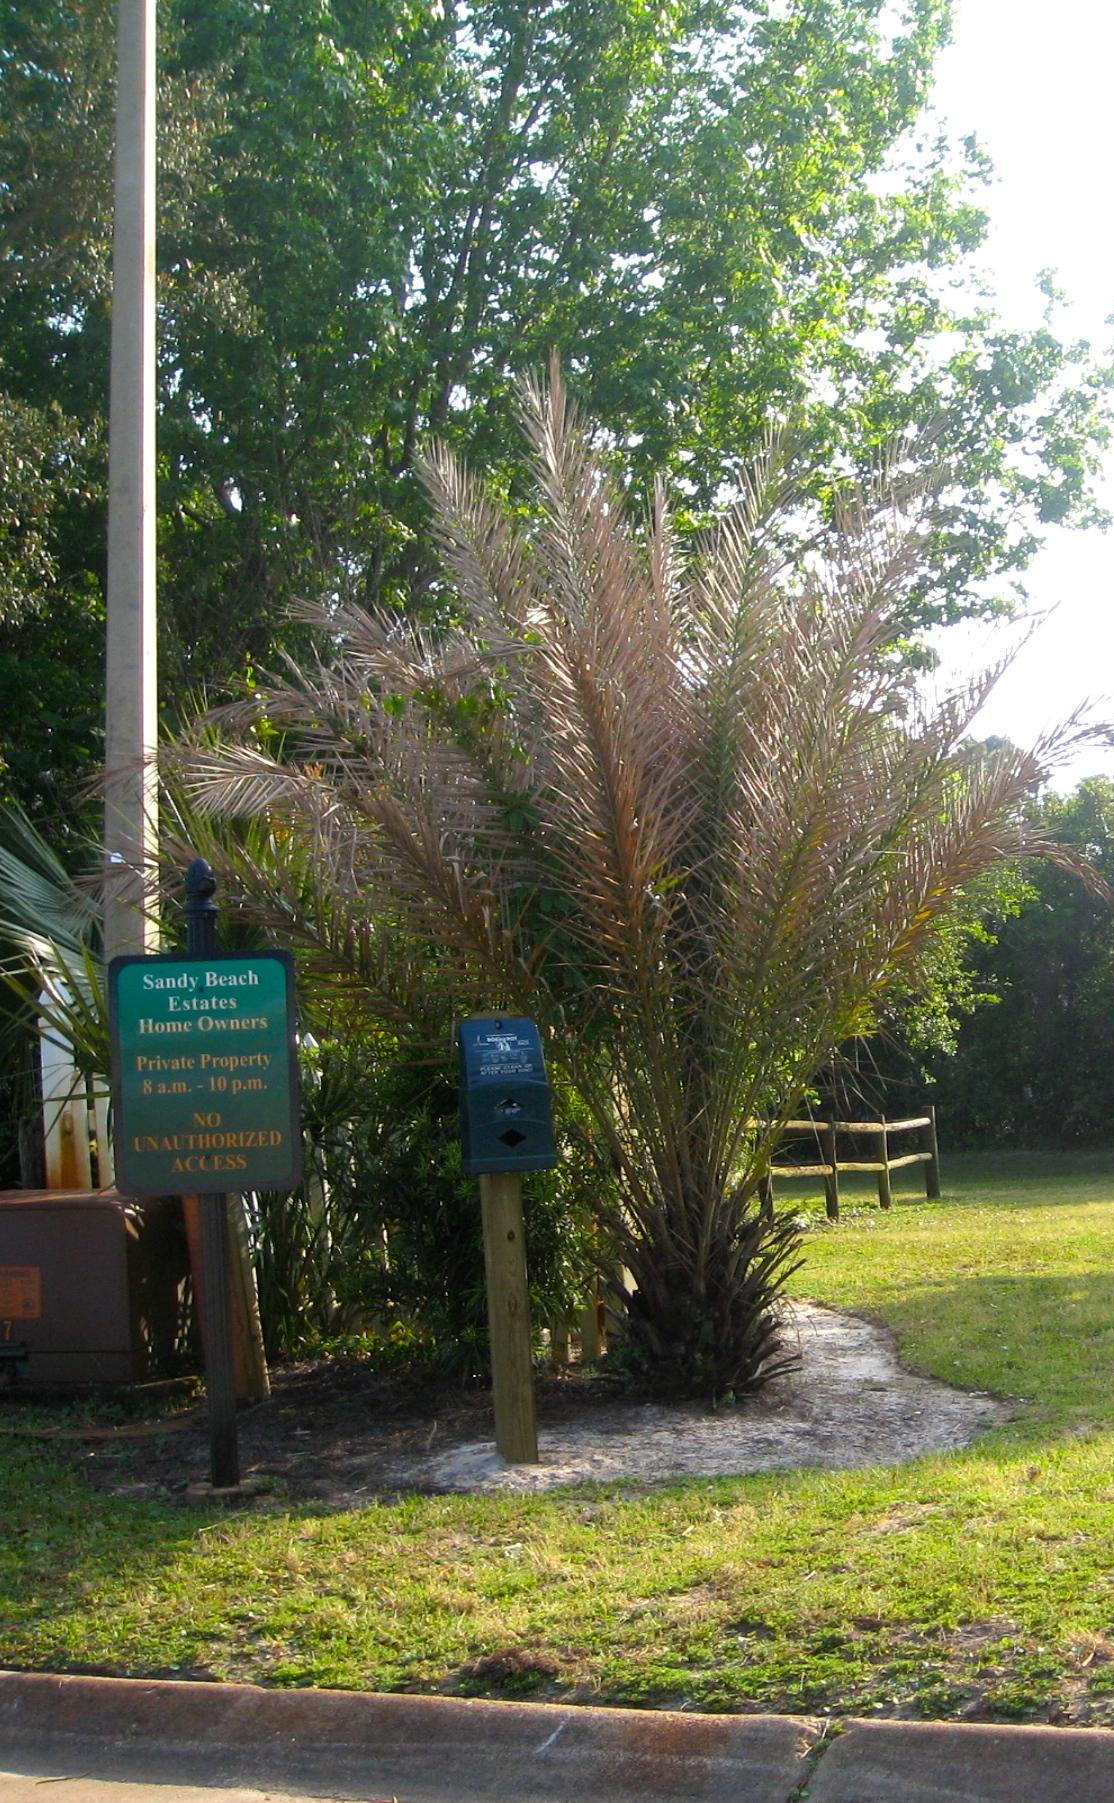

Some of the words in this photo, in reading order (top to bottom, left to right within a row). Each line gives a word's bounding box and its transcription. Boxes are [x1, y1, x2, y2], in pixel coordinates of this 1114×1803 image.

[143, 973, 199, 991] Sandy
[205, 970, 259, 987] Beach
[168, 996, 237, 1011] Estates
[139, 1019, 192, 1034] Home
[198, 1016, 269, 1031] Owners
[137, 1055, 195, 1071] Private
[201, 1052, 272, 1070] Property
[143, 1079, 152, 1094] 8
[158, 1082, 192, 1094] a.m.
[209, 1076, 227, 1092] 10
[232, 1079, 268, 1094] p.m.
[193, 1112, 221, 1128] NO
[134, 1130, 282, 1152] UNAUTHORIZED
[172, 1154, 247, 1173] ACCESS
